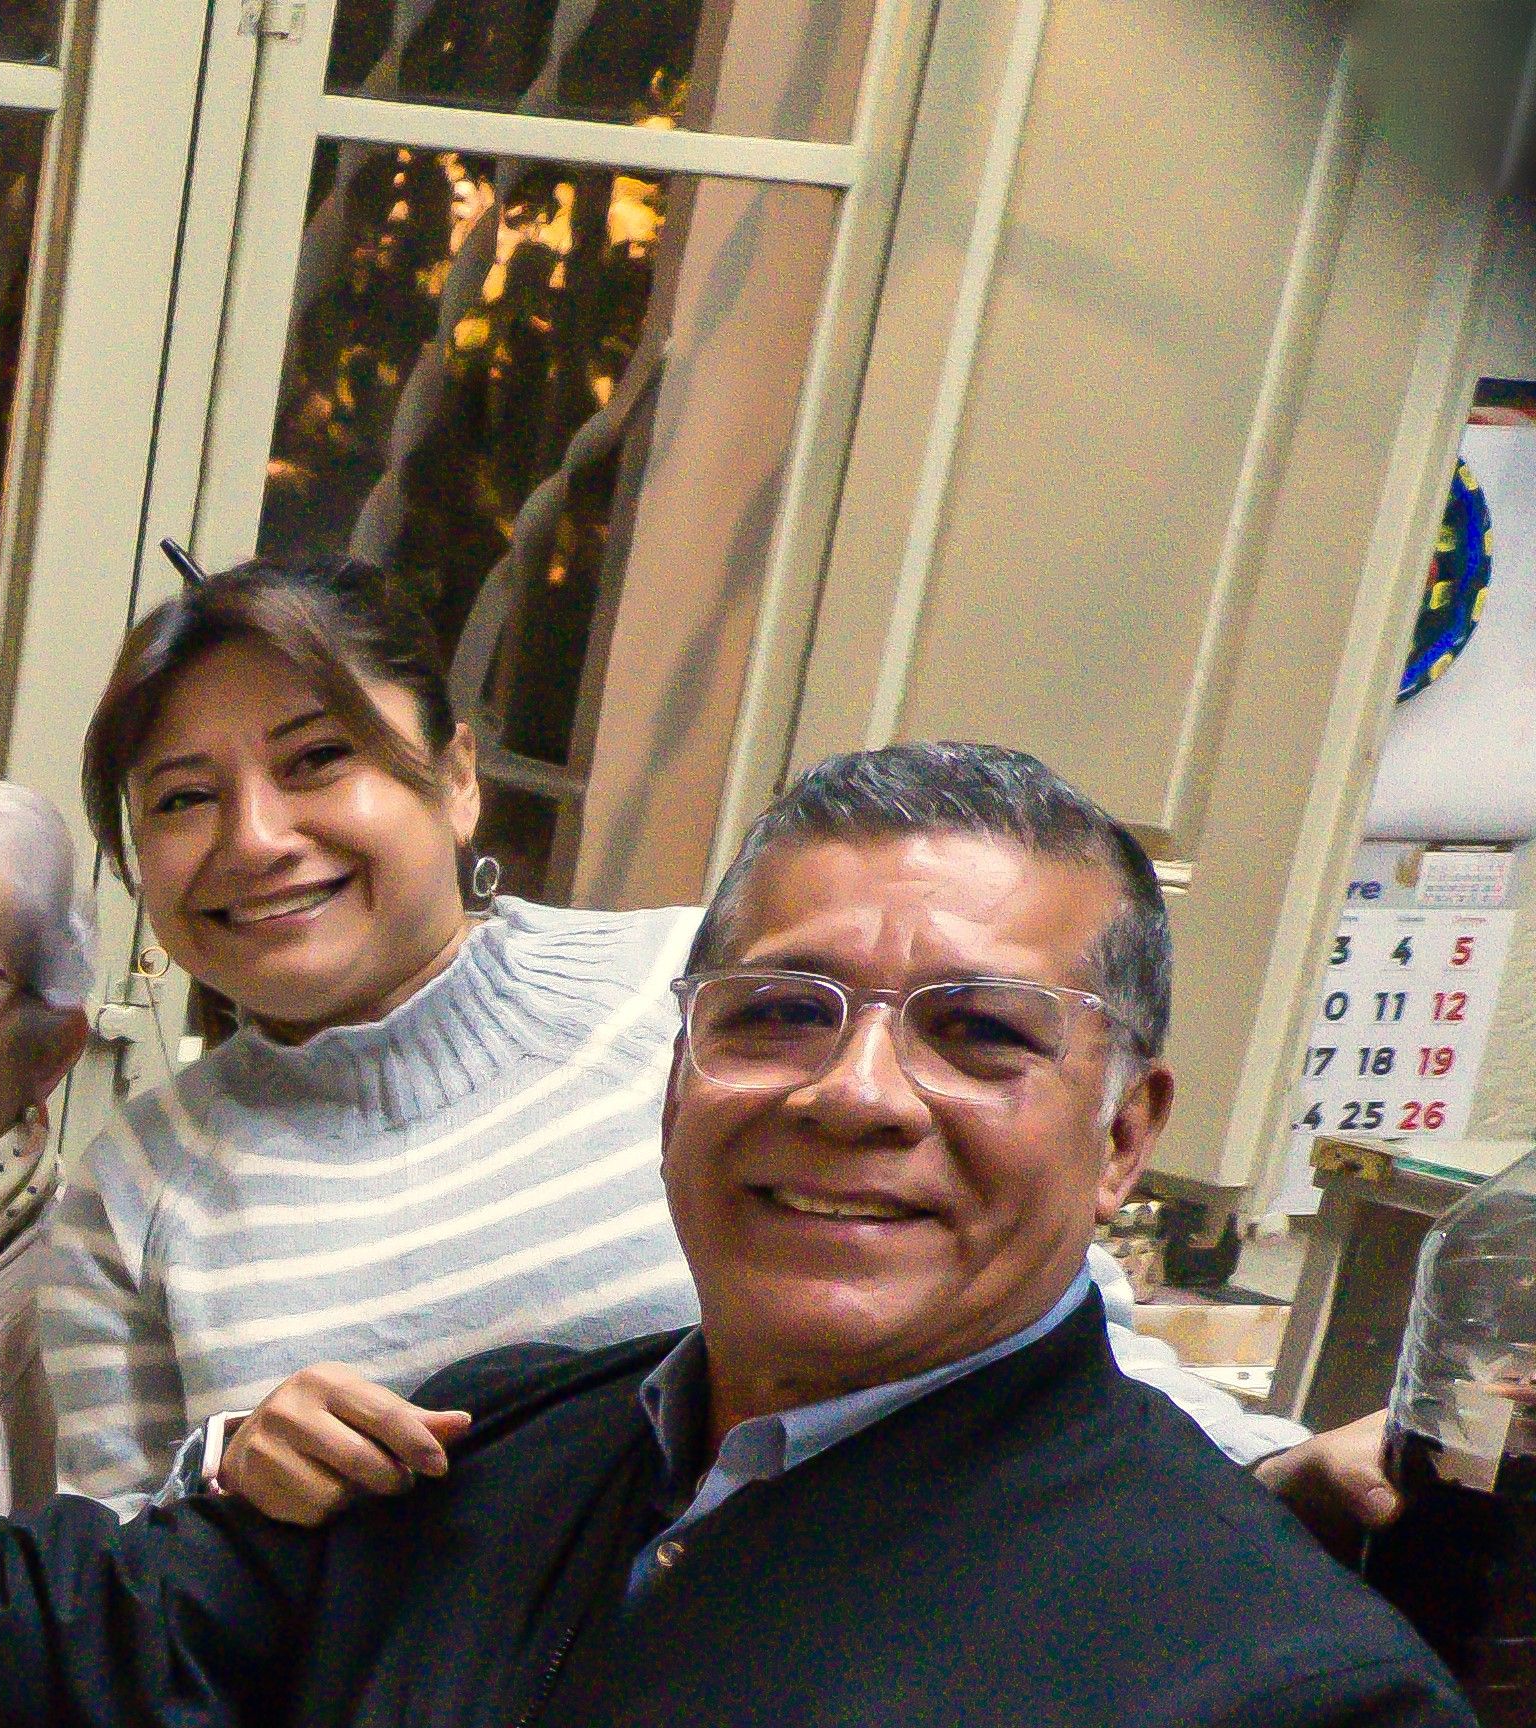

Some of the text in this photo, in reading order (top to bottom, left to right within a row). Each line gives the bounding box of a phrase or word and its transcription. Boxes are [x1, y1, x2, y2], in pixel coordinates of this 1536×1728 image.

[1347, 879, 1382, 900] re
[1329, 936, 1475, 966] 3 4 5
[1324, 991, 1468, 1021] 0 11 12
[1358, 1047, 1396, 1076] 18
[1419, 1047, 1455, 1076] 19
[1291, 1101, 1446, 1130] 4 25 26
